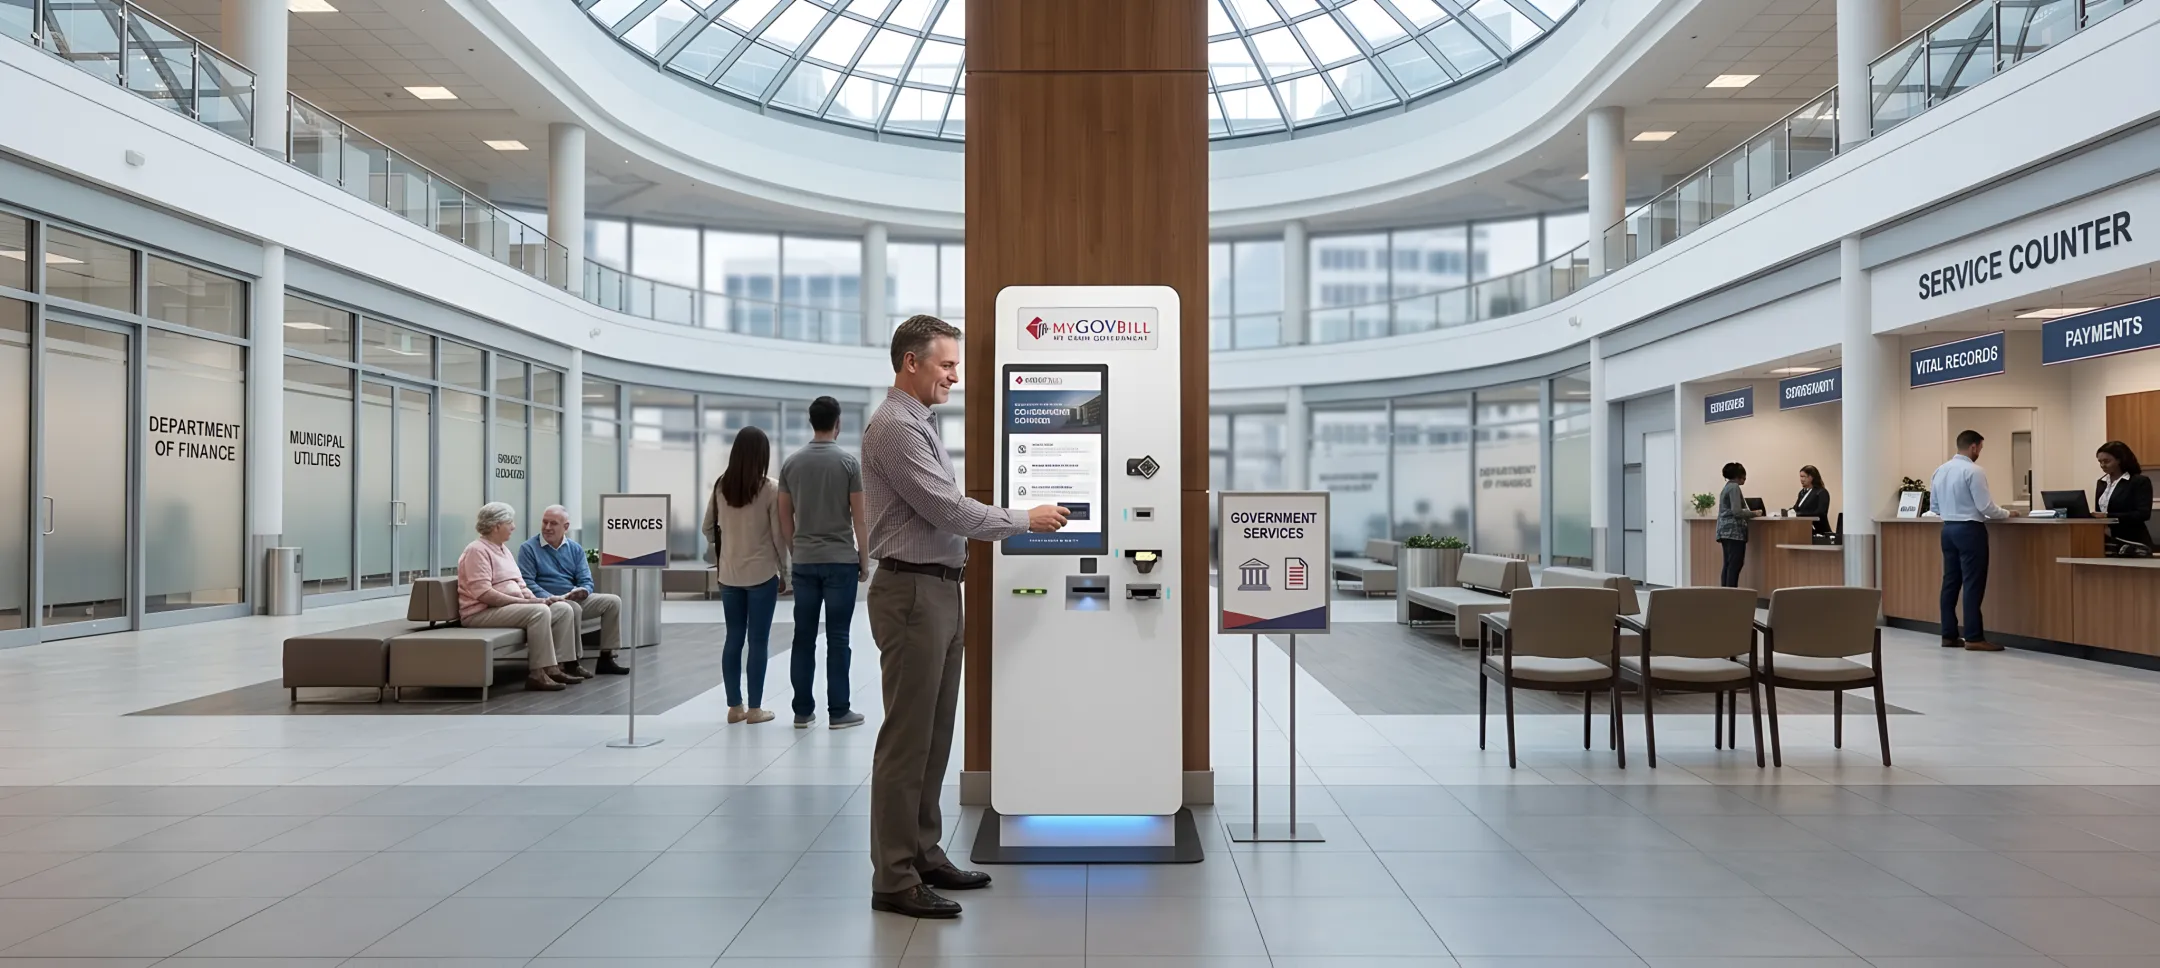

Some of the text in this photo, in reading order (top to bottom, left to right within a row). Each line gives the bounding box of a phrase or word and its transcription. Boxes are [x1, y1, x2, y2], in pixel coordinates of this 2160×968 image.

[1918, 211, 2133, 300] SERVICE COUNTER
[1053, 319, 1151, 334] MYGOVBILL
[2065, 315, 2143, 348] PAYMENTS
[1916, 357, 1944, 375] VITAL
[149, 415, 241, 440] DEPARTMENT
[290, 430, 345, 449] MUNICIPAL
[155, 440, 236, 461] OF FINANCE
[607, 518, 663, 530] SERVICES
[1230, 512, 1317, 524] GOVERNMENT
[1243, 527, 1304, 539] SERVICES
